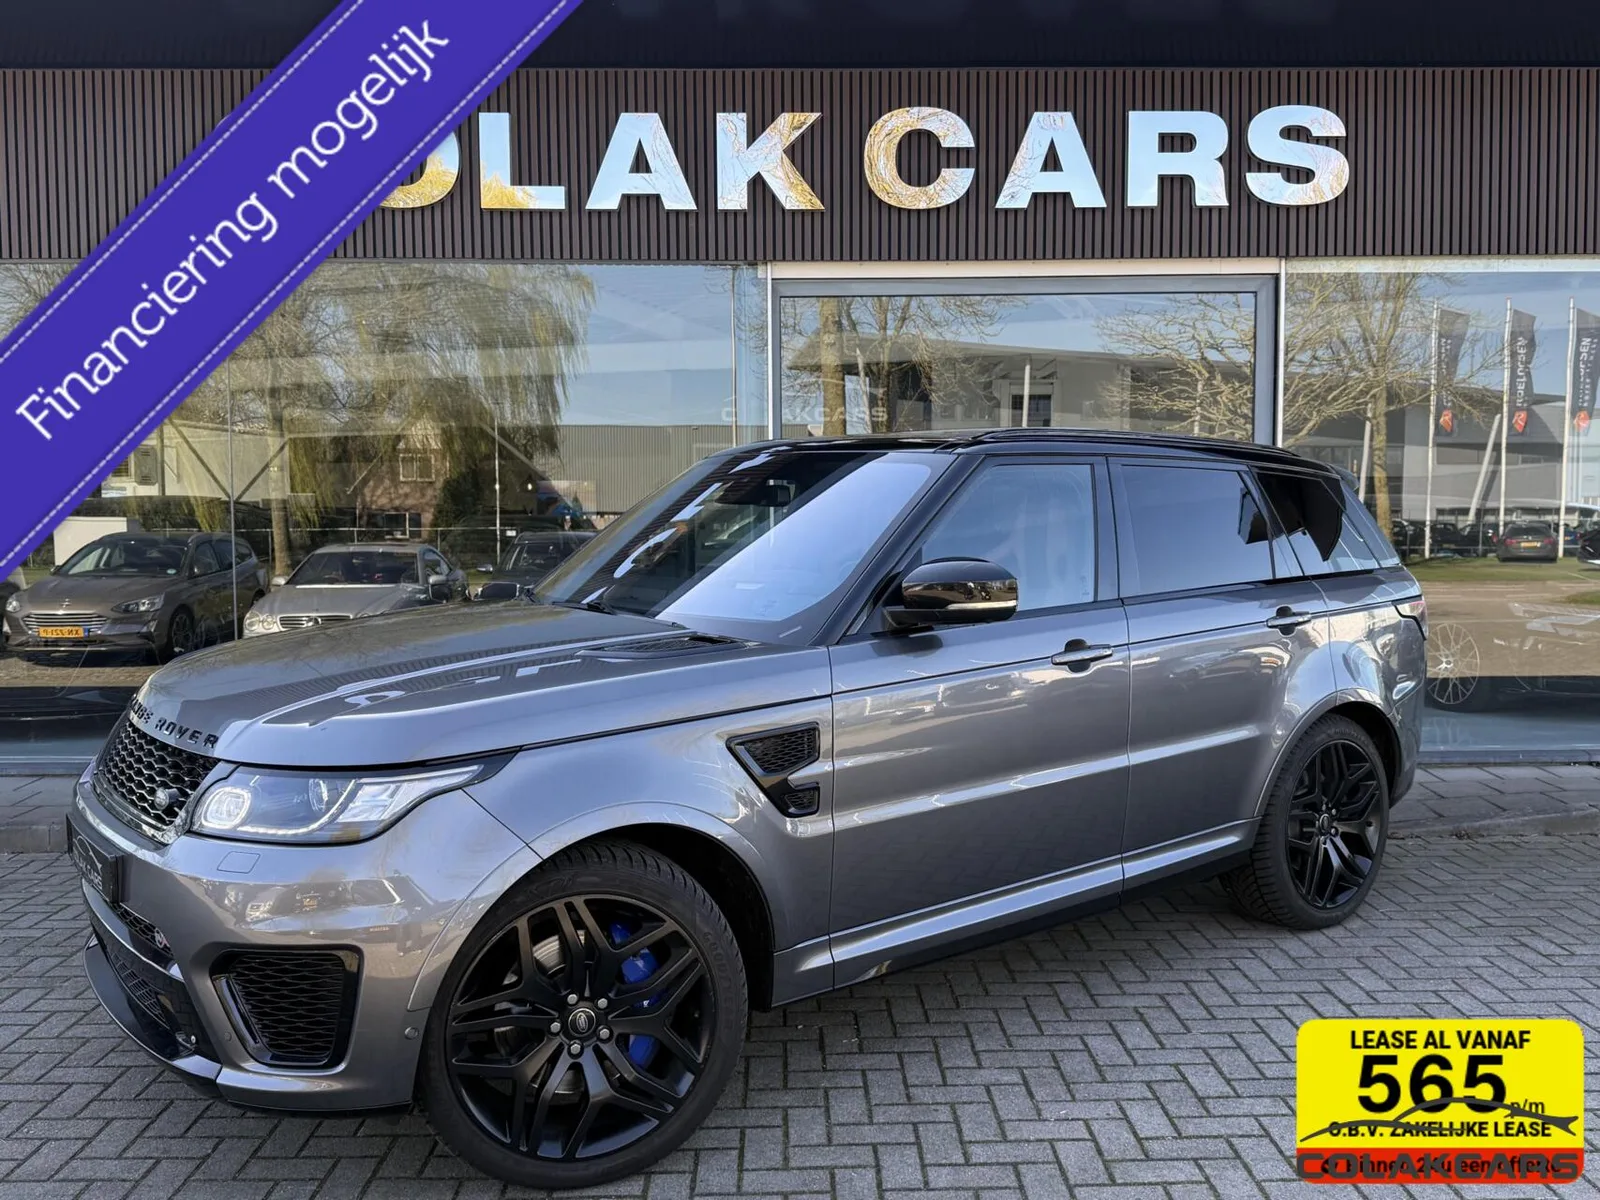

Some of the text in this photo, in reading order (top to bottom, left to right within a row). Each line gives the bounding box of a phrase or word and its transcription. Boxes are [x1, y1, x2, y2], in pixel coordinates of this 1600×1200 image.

[378, 105, 1349, 211] LAK CARS
[155, 717, 219, 749] ROVER
